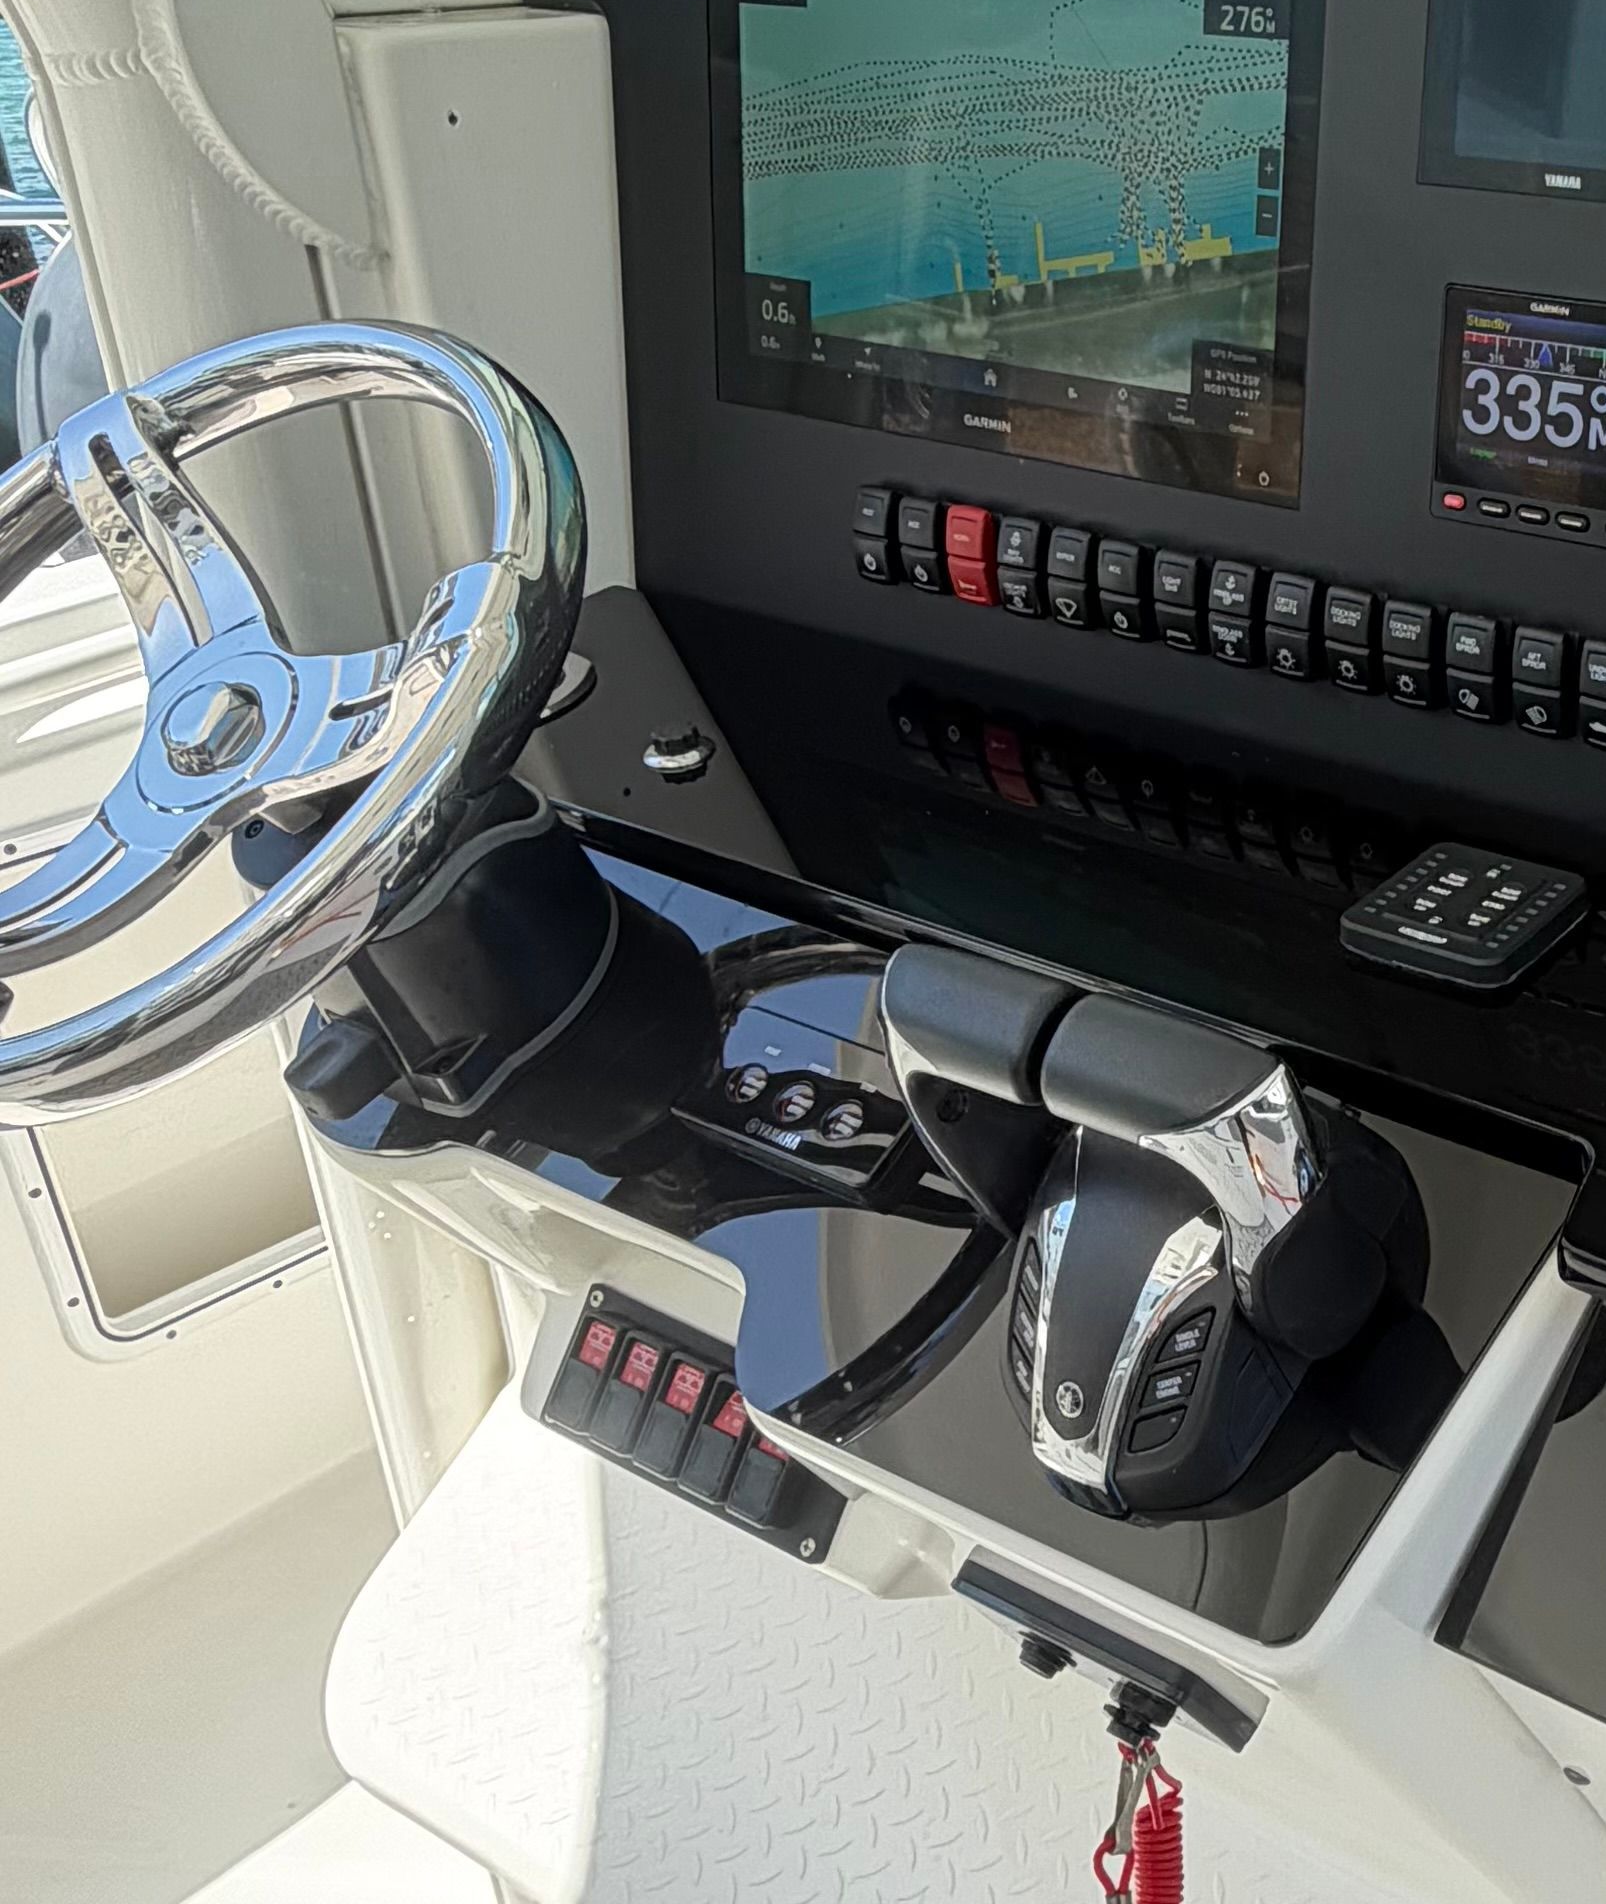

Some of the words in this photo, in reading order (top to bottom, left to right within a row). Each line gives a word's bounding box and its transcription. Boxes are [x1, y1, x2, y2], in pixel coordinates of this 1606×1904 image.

[1530, 302, 1570, 316] GARMIN
[1466, 314, 1512, 333] Standby
[963, 413, 1012, 433] GARMIN
[757, 1120, 802, 1151] YAMAHA
